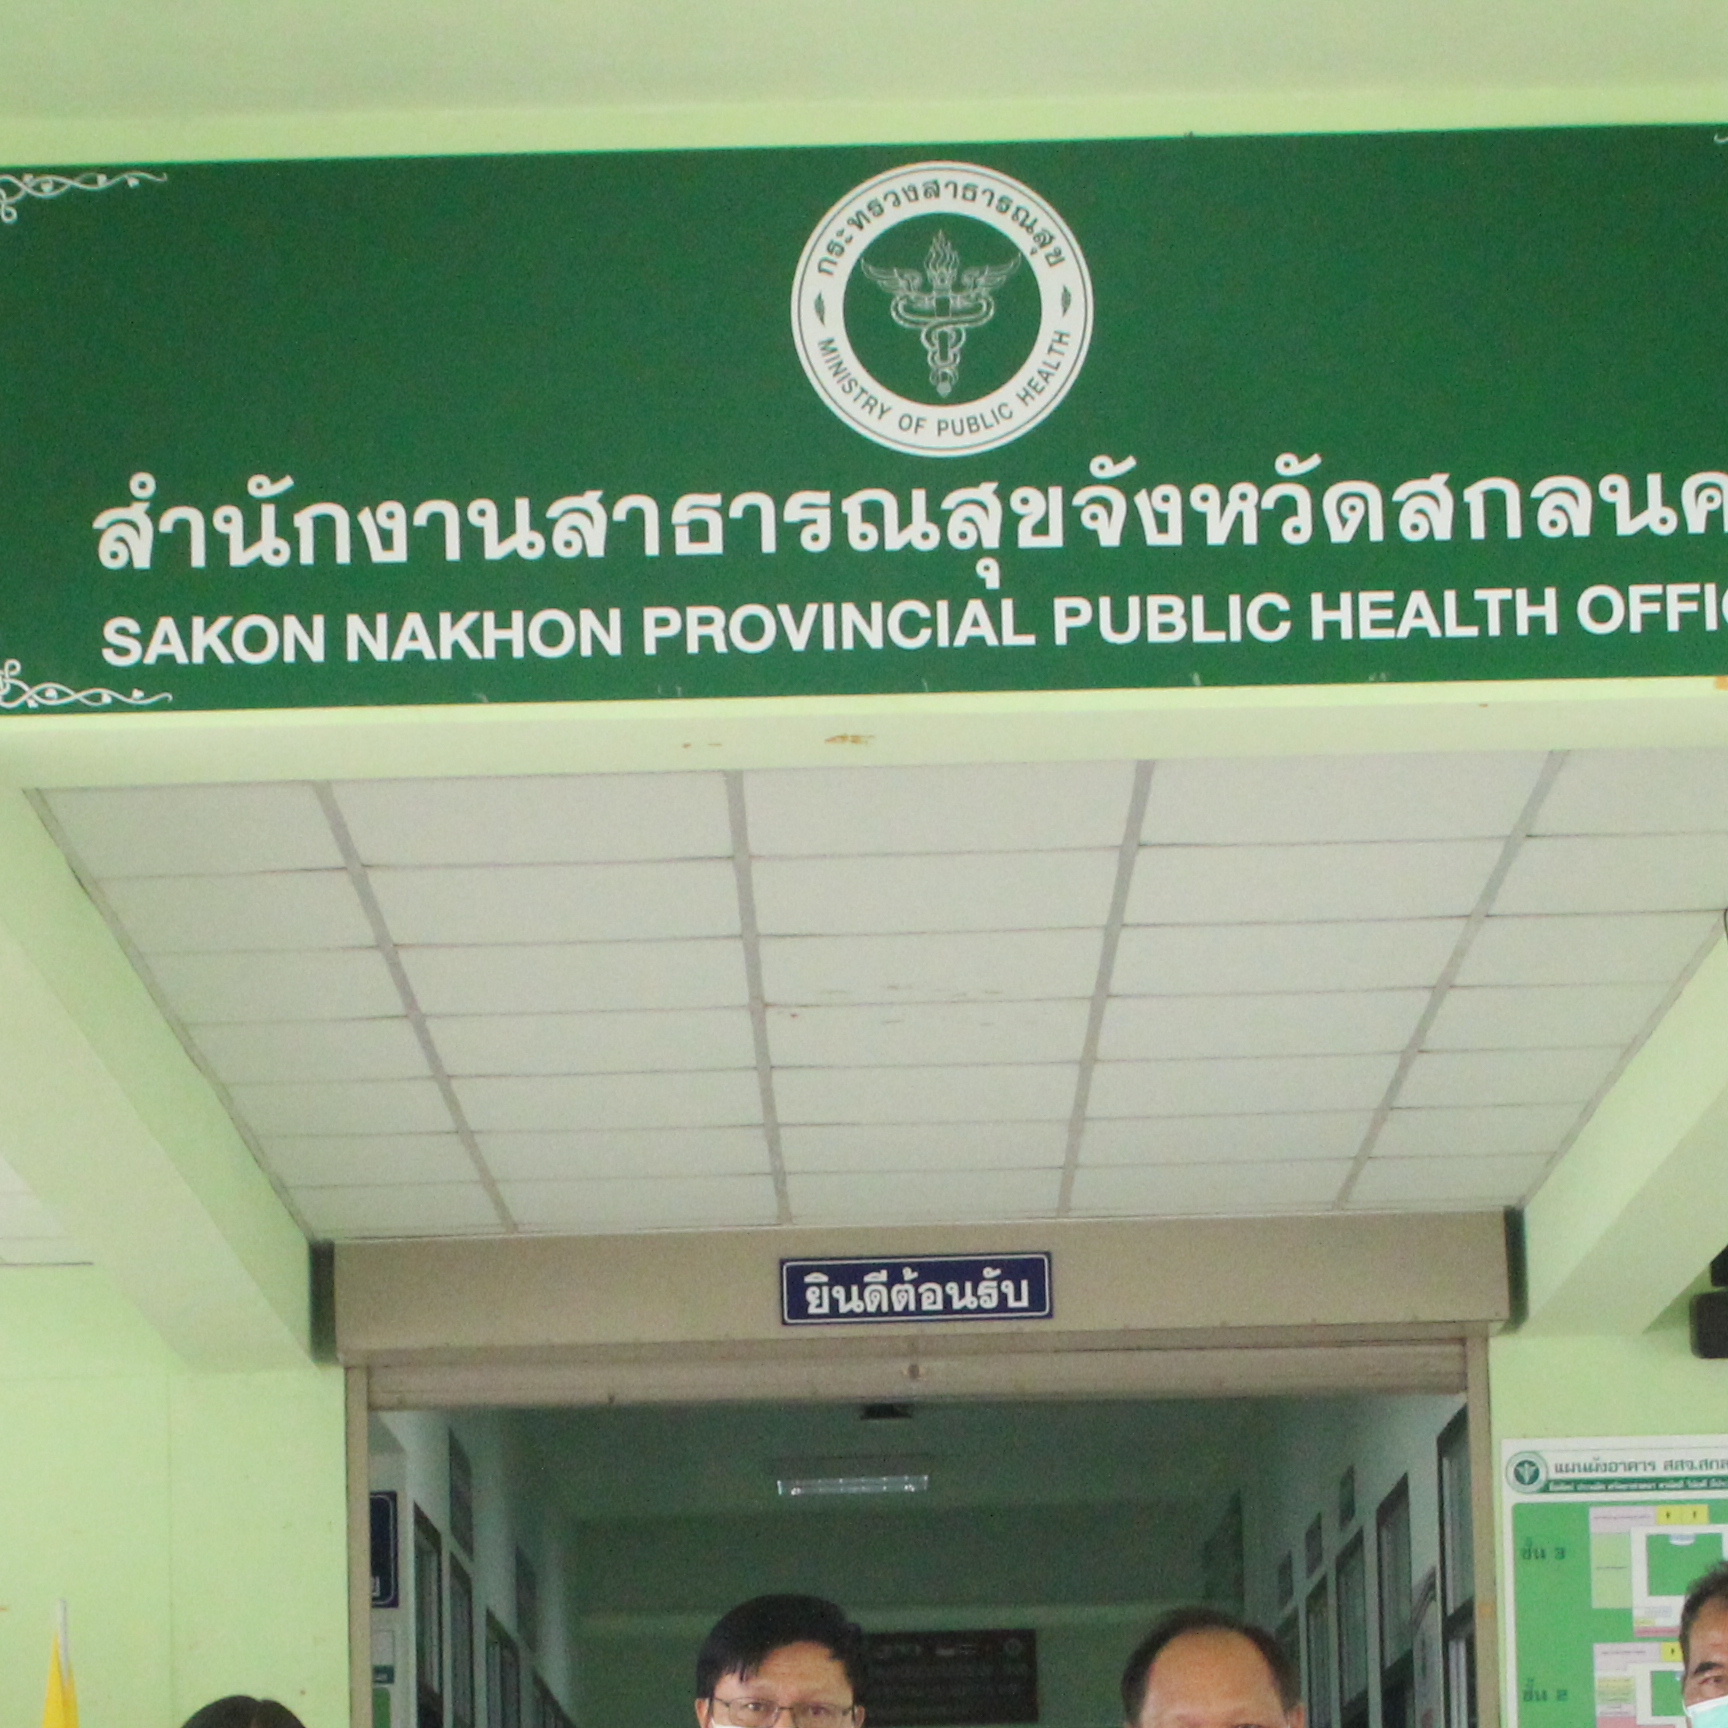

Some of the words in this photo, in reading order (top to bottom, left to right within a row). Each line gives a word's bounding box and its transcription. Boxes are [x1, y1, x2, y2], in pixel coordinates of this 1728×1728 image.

[817, 178, 1066, 277] กระทรวงสาธารณสุข
[818, 336, 893, 421] MINISTRY
[897, 412, 927, 435] OF
[936, 401, 1014, 437] PUBLIC
[1015, 329, 1071, 408] HEALTH
[102, 613, 324, 667] SAKON
[347, 607, 621, 662] NAKHON
[643, 598, 1036, 655] PROVINCIAL
[1055, 593, 1291, 645] PUBLIC
[1311, 587, 1557, 641] HEALTH
[803, 1266, 1029, 1315] ยินดีต้อนรับ
